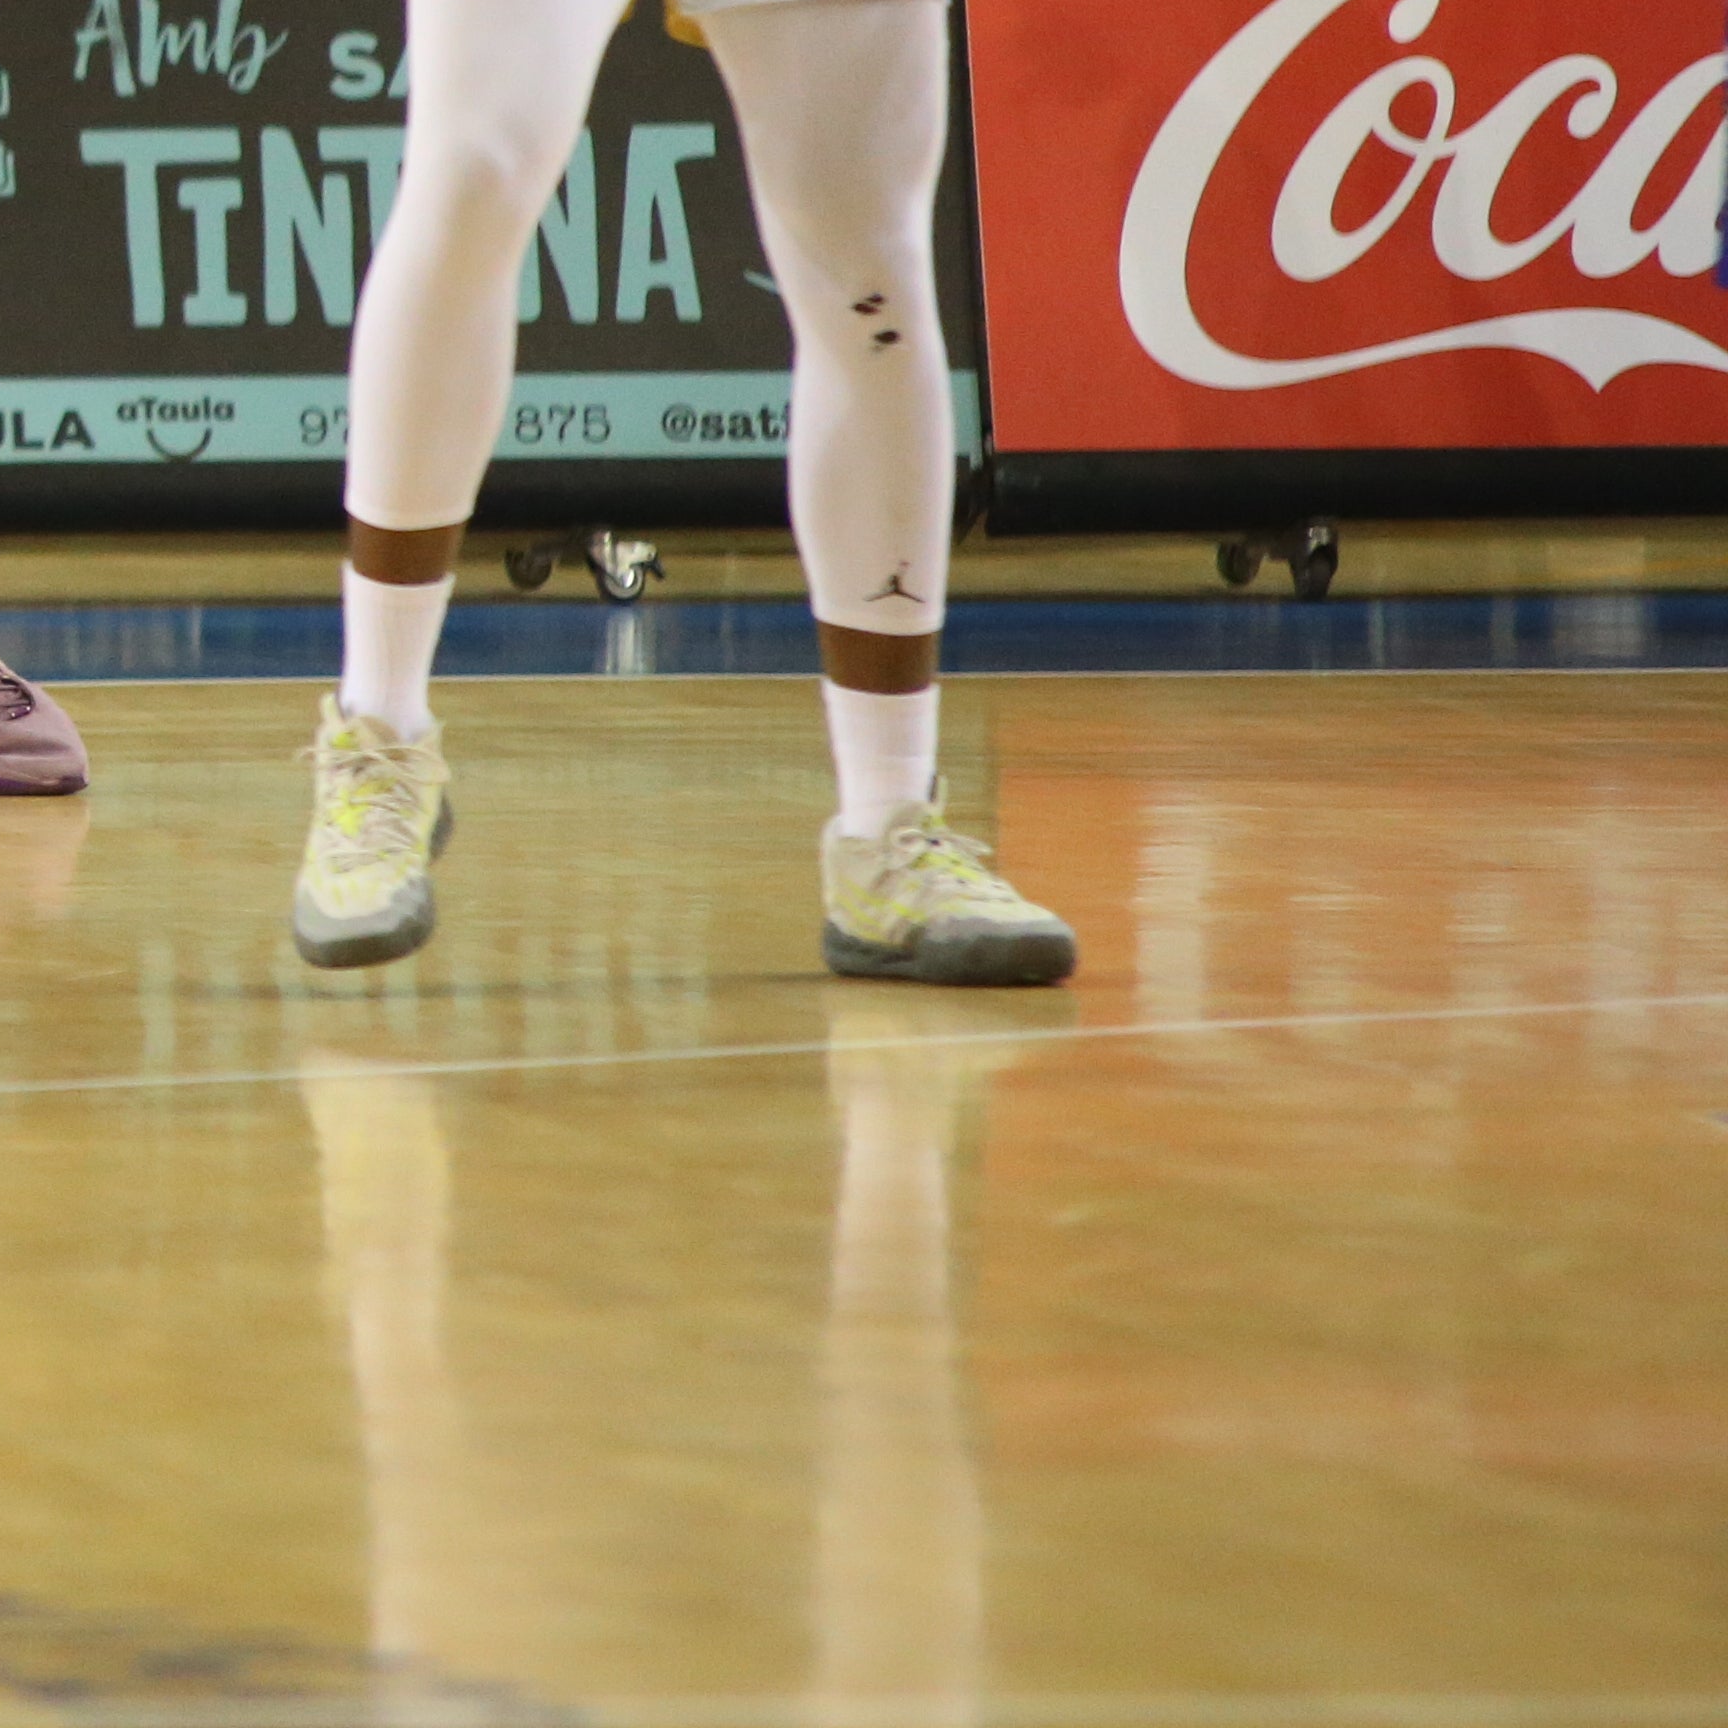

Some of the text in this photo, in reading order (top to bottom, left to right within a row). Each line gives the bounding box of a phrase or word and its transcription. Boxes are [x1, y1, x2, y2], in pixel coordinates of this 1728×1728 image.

[329, 31, 409, 101] S
[116, 398, 236, 423] aTaula
[514, 404, 613, 444] 875
